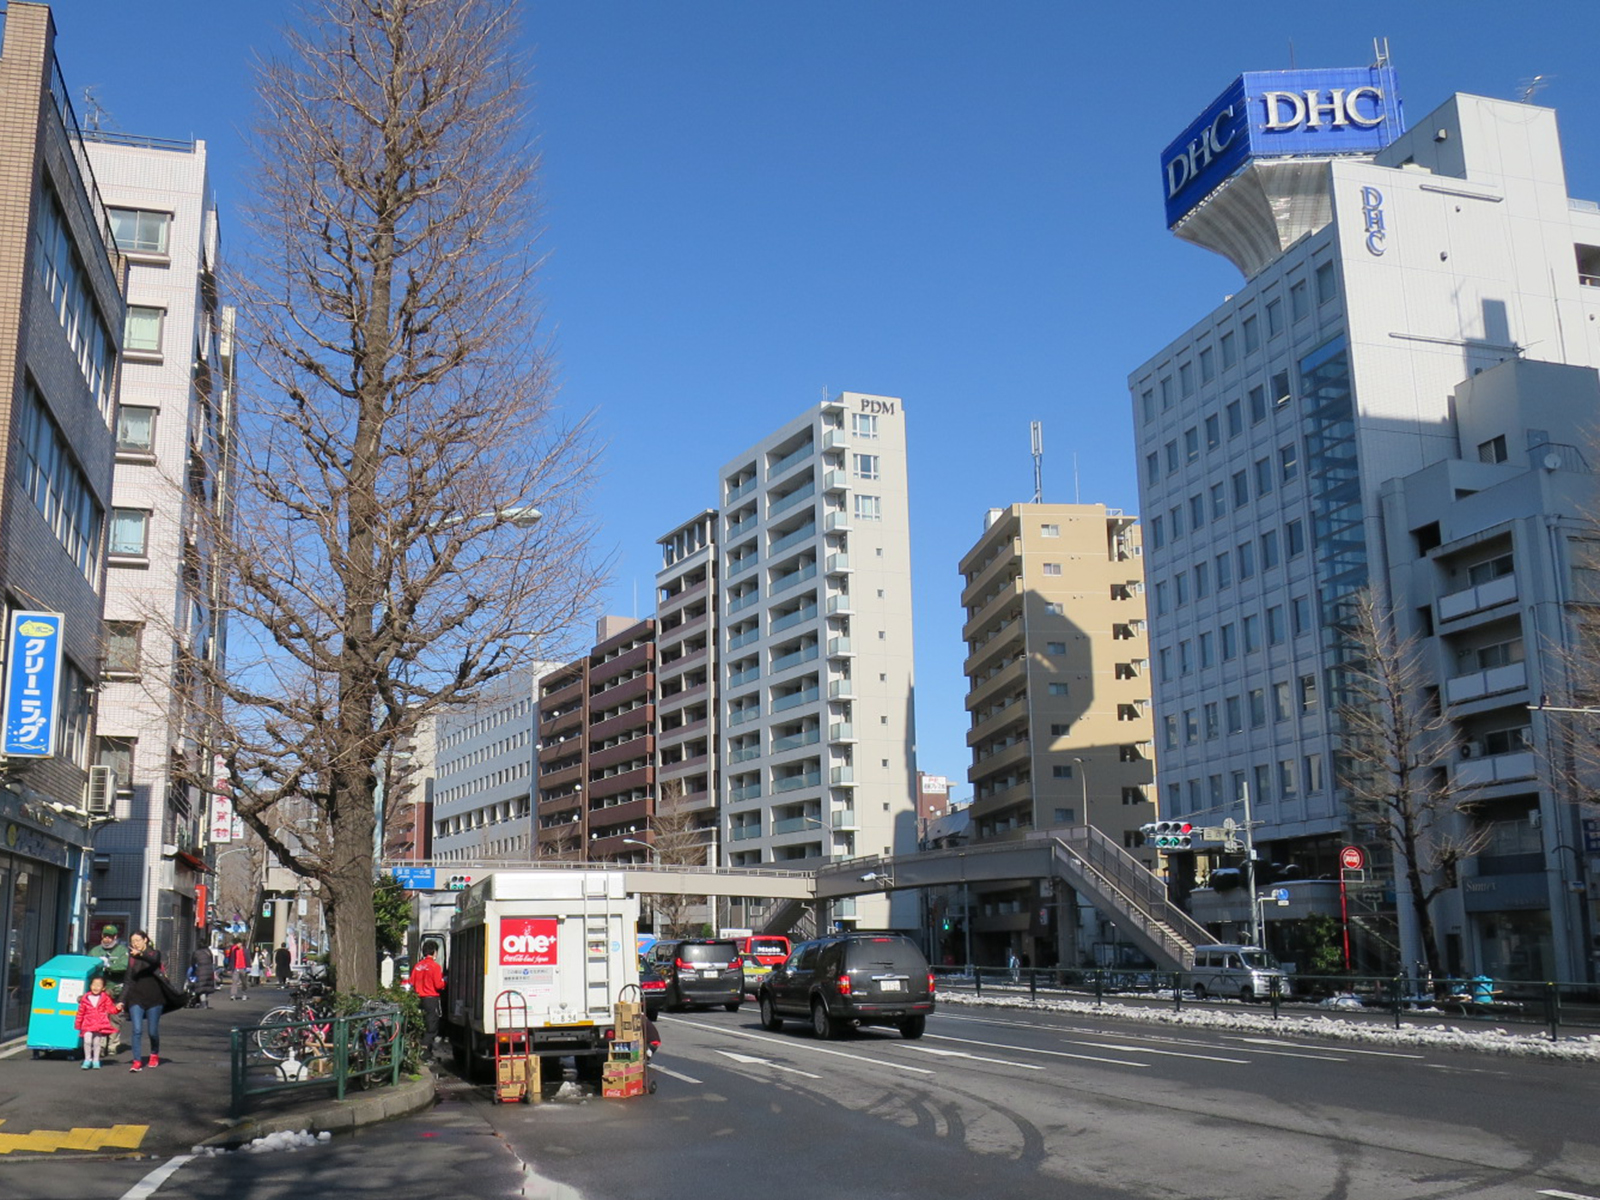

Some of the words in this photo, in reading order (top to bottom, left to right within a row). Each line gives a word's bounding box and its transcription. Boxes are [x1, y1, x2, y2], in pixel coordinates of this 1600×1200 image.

[1262, 86, 1387, 129] DHC
[1166, 105, 1236, 200] DHC
[1361, 186, 1387, 256] DHC
[861, 398, 895, 415] PDM
[19, 638, 47, 743] クリーニング
